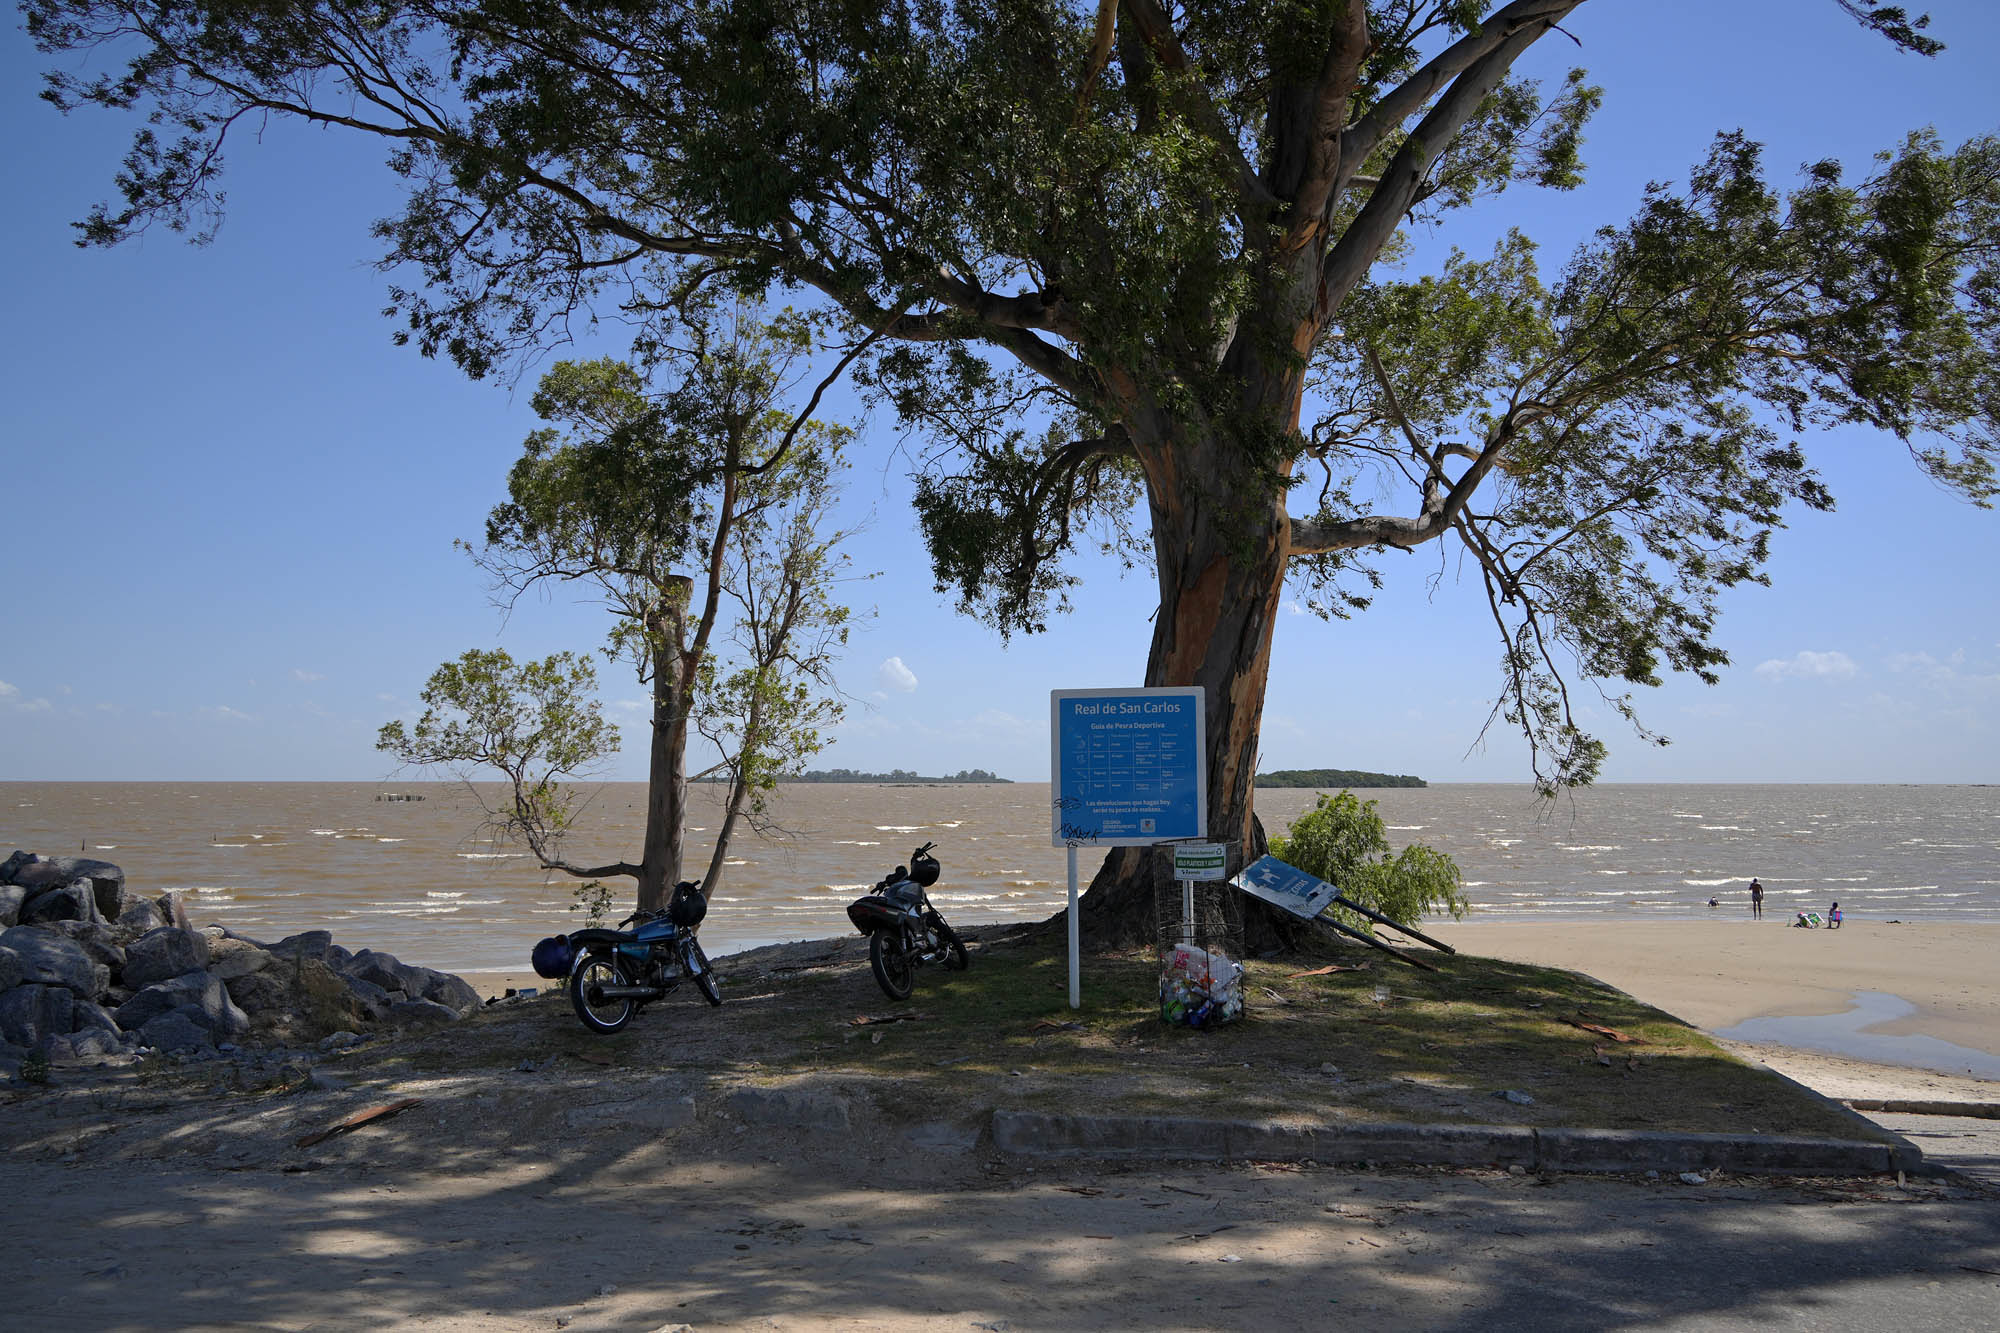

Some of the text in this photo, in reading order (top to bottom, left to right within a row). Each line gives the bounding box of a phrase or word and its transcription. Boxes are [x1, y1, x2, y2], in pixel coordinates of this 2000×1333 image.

[1075, 701, 1181, 715] Real de San Carlos
[1134, 721, 1165, 730] Deportiva
